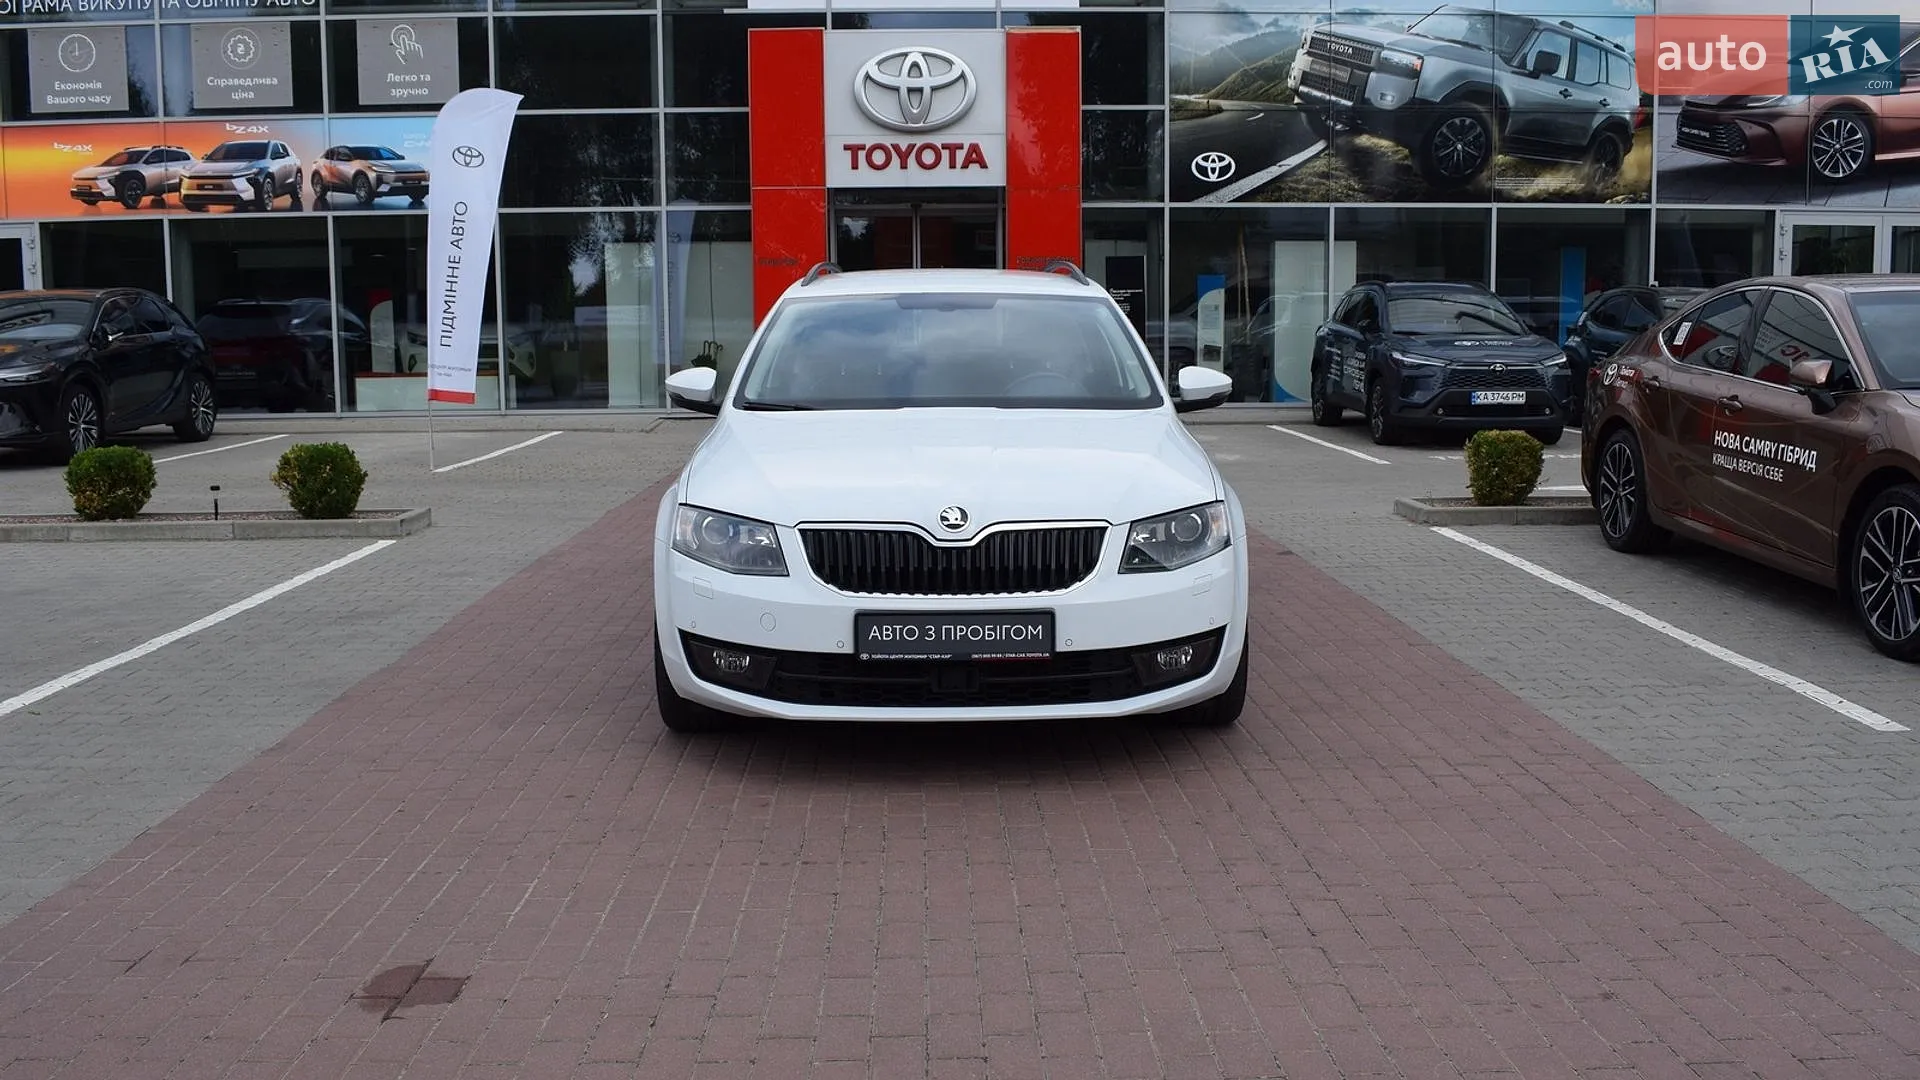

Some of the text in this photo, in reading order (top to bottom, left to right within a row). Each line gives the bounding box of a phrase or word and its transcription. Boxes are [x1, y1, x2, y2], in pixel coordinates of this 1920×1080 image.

[207, 76, 279, 87] Справедлива
[386, 73, 418, 82] Легко
[54, 80, 102, 91] Економія
[46, 95, 112, 104] Вашого часу
[231, 89, 255, 100] ціна
[390, 88, 429, 98] зручно
[843, 142, 989, 170] TOYOTA
[450, 201, 468, 251] АВТО
[440, 254, 462, 347] ПІДМІННЕ
[1714, 430, 1817, 472] НОВА CAMRY ГІБРИД
[1712, 453, 1784, 482] КРАЩА ВЕРСІЯ СЕБЕ
[868, 624, 1043, 641] АВТО З ПРОБІГОМ
